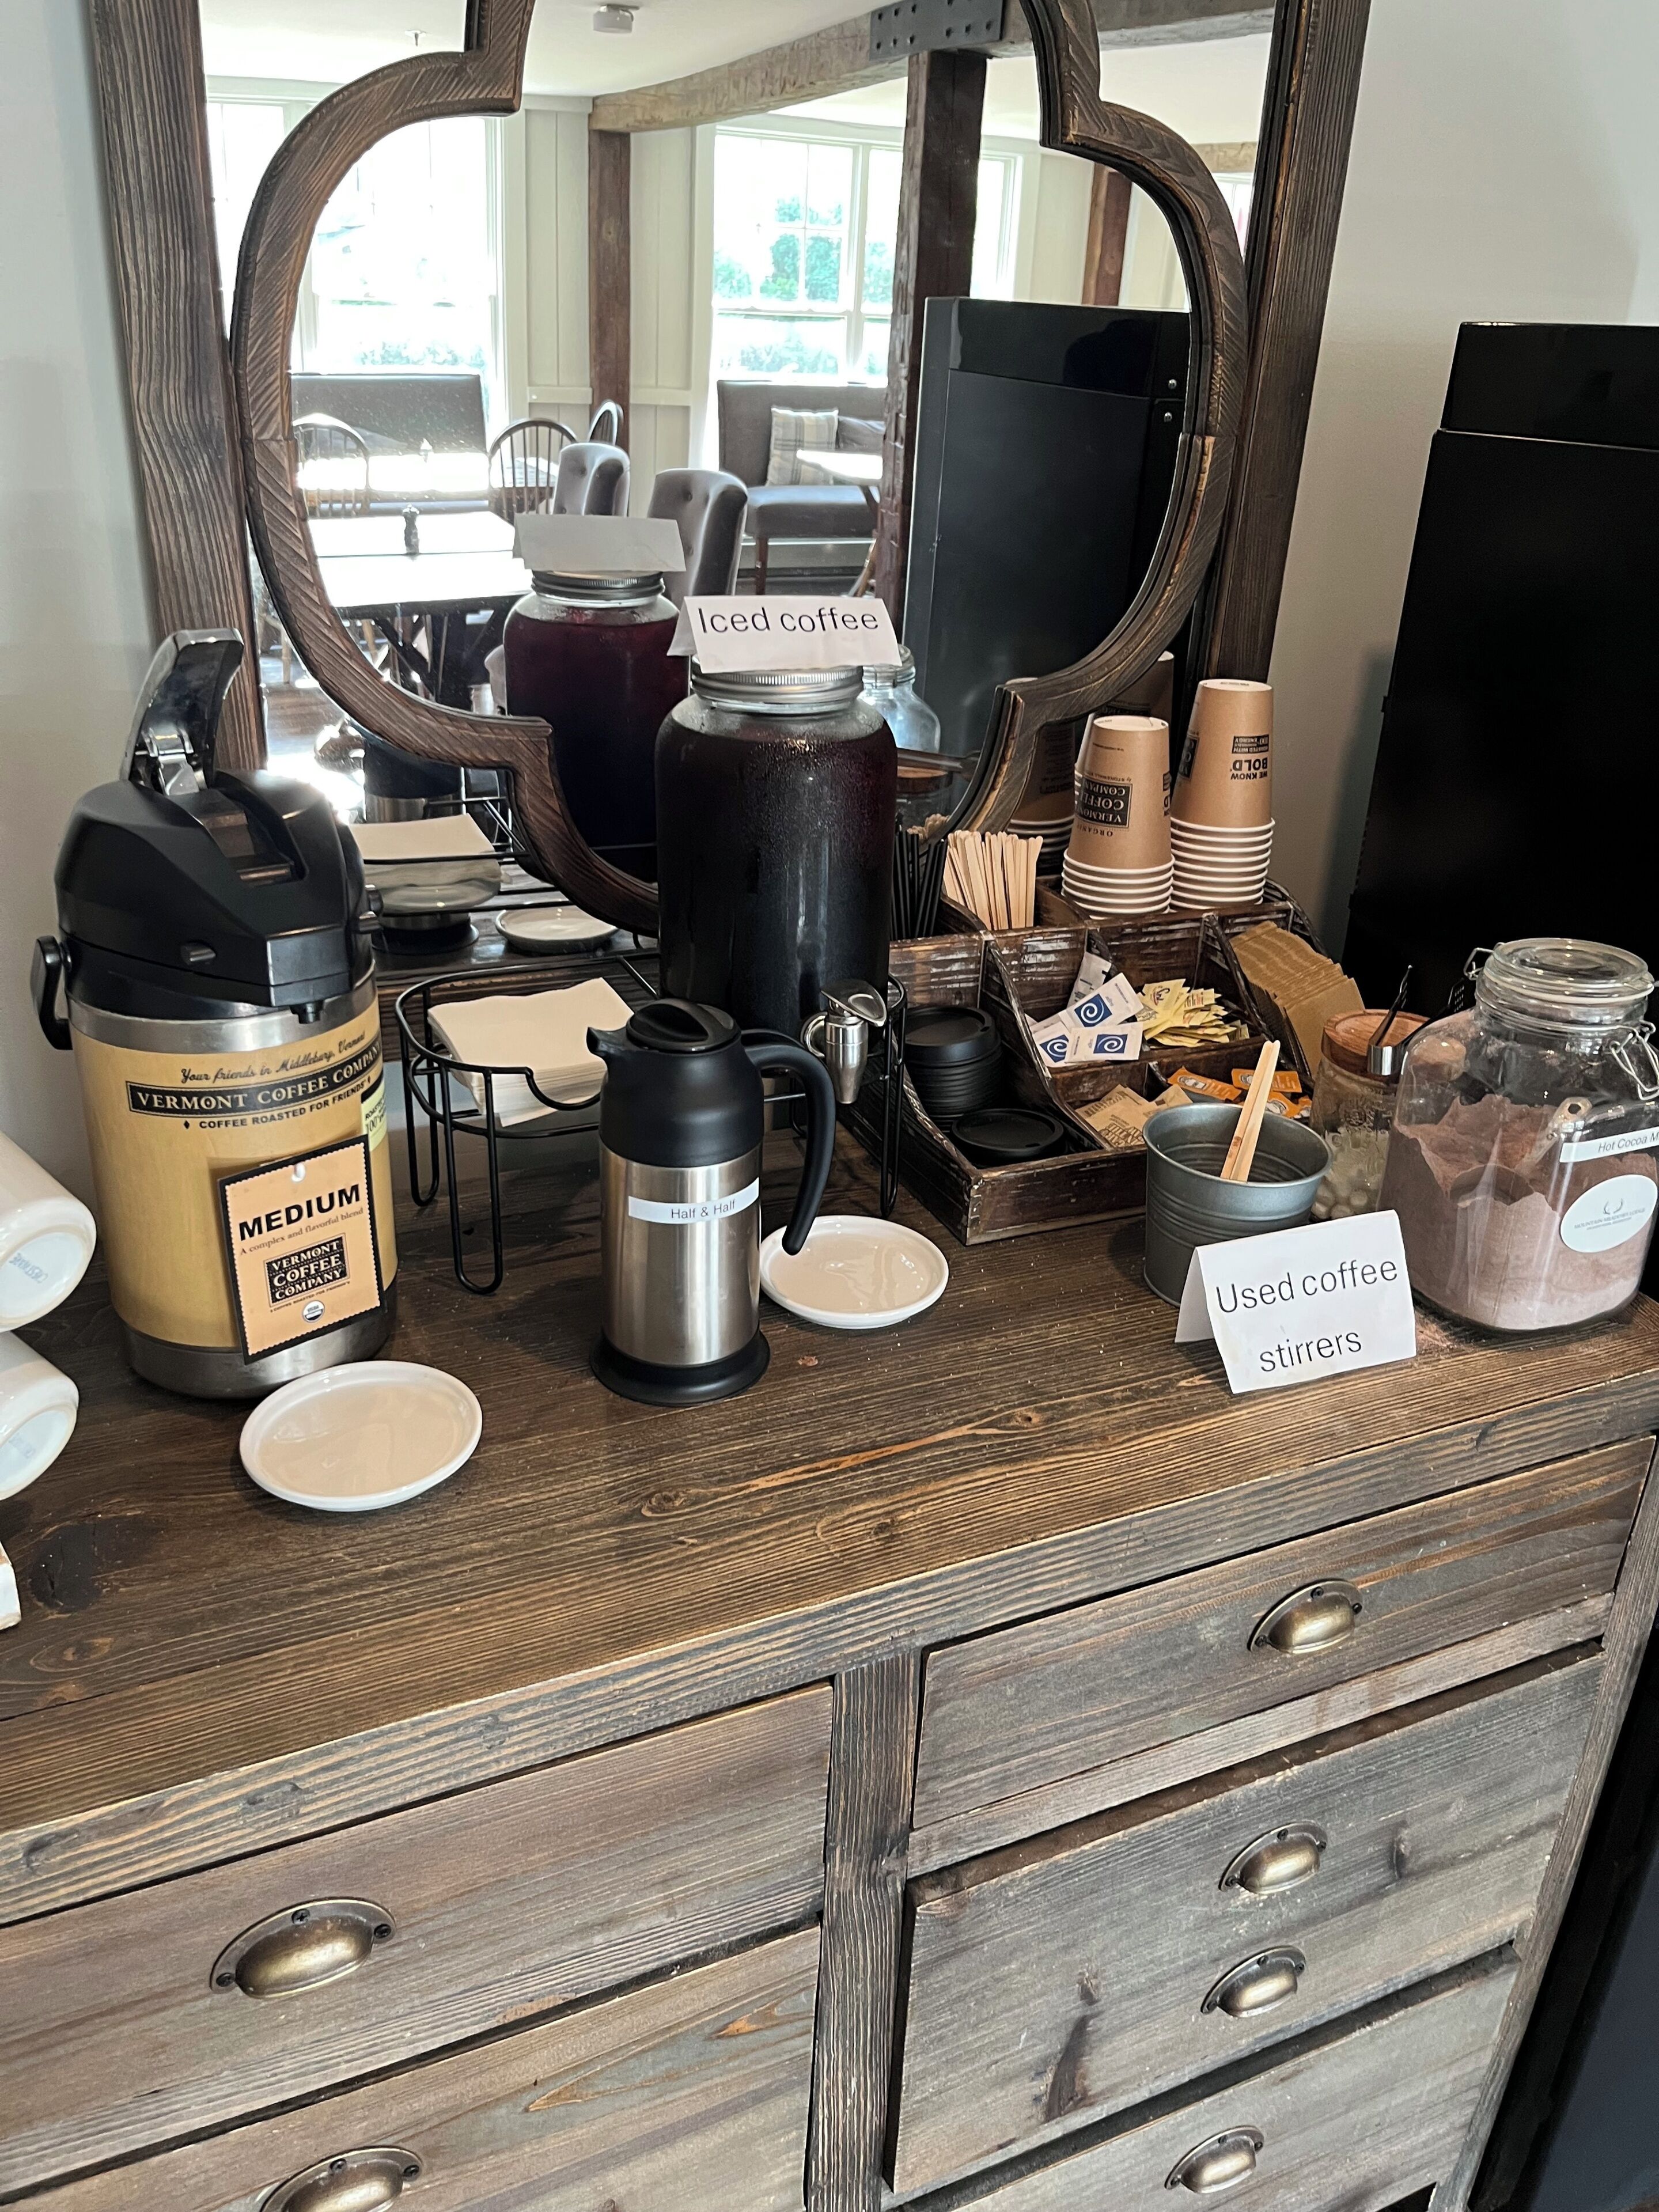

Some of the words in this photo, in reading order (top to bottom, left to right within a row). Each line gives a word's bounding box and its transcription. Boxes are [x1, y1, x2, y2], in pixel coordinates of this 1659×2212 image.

[698, 607, 771, 633] Iced
[780, 607, 878, 632] coffee
[1233, 757, 1268, 771] BOLD
[181, 1068, 211, 1084] Your
[212, 1065, 257, 1084] friends
[260, 1063, 272, 1075] in
[137, 1092, 248, 1110] VERMONT
[257, 1075, 329, 1104] COFFEE
[199, 1118, 248, 1129] COFFEE
[252, 1107, 306, 1124] ROASTED
[309, 1099, 330, 1112] FOR
[1598, 1141, 1615, 1153] Hot
[1618, 1136, 1647, 1149] Cocoa
[1650, 1131, 1659, 1143] M
[238, 1184, 361, 1241] MEDIUM
[671, 1207, 696, 1219] Half
[700, 1206, 709, 1217] &
[714, 1199, 736, 1215] Half
[240, 1248, 247, 1256] A
[249, 1235, 286, 1252] complex
[288, 1228, 303, 1239] and
[305, 1216, 339, 1233] flavorful
[341, 1207, 364, 1220] blend
[272, 1240, 340, 1271] VERMONT
[273, 1253, 342, 1287] COFFEE
[275, 1268, 342, 1300] COMPANY
[1215, 1272, 1295, 1313] Used
[1301, 1259, 1398, 1297] coffee
[1259, 1331, 1362, 1373] stirrers
